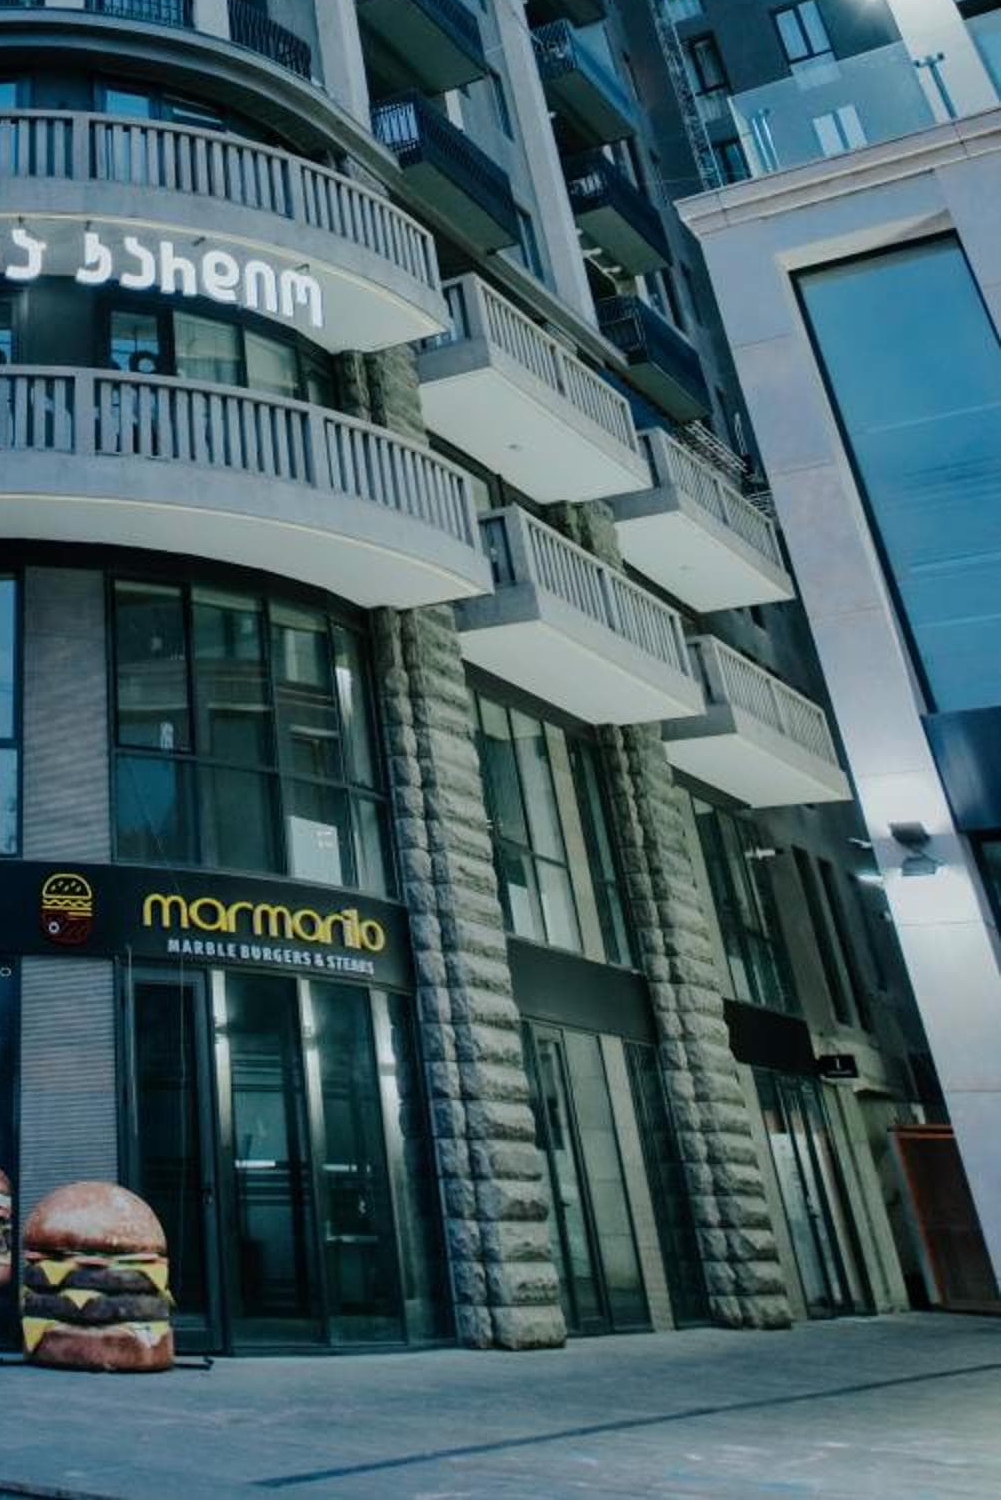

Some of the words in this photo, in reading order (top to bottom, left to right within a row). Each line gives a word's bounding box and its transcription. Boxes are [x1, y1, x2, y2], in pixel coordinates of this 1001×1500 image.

[74, 231, 324, 328] კარდიო
[142, 892, 386, 951] marmarilo
[167, 938, 238, 958] MARBLE
[240, 943, 312, 966] BURGERS
[313, 953, 324, 967] &
[326, 955, 375, 975] STEAKS
